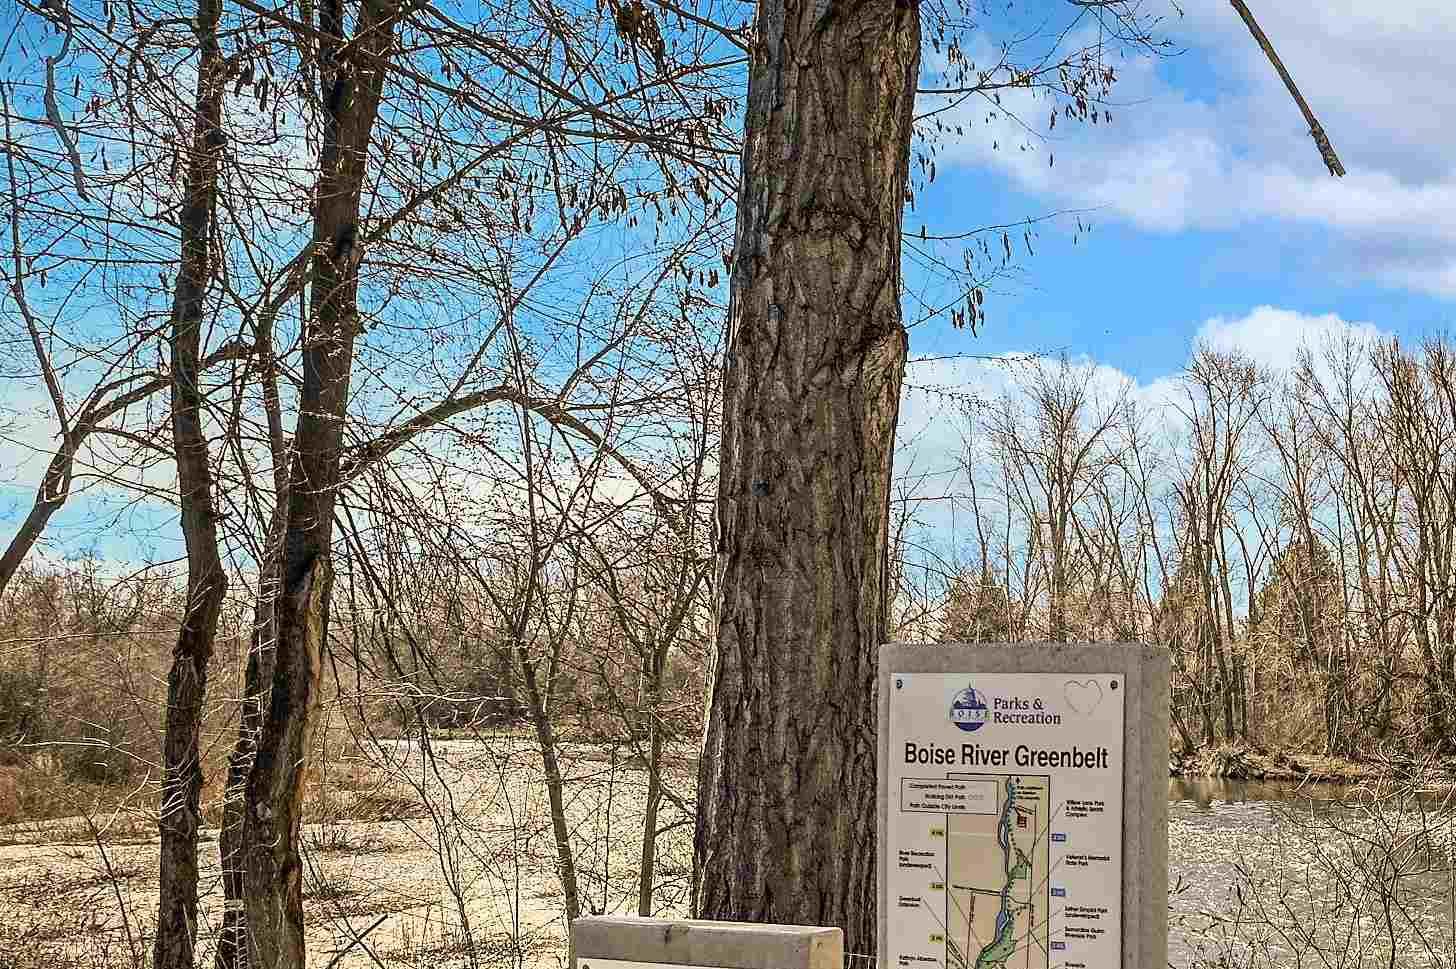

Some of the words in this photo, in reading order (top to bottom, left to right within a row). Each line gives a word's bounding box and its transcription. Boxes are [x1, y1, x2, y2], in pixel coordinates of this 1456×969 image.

[994, 697, 1030, 710] Parks
[1033, 698, 1044, 710] &
[994, 712, 1060, 724] Recreation
[904, 742, 956, 765] Boise
[962, 744, 1010, 766] River
[1014, 745, 1108, 768] Greenbelt
